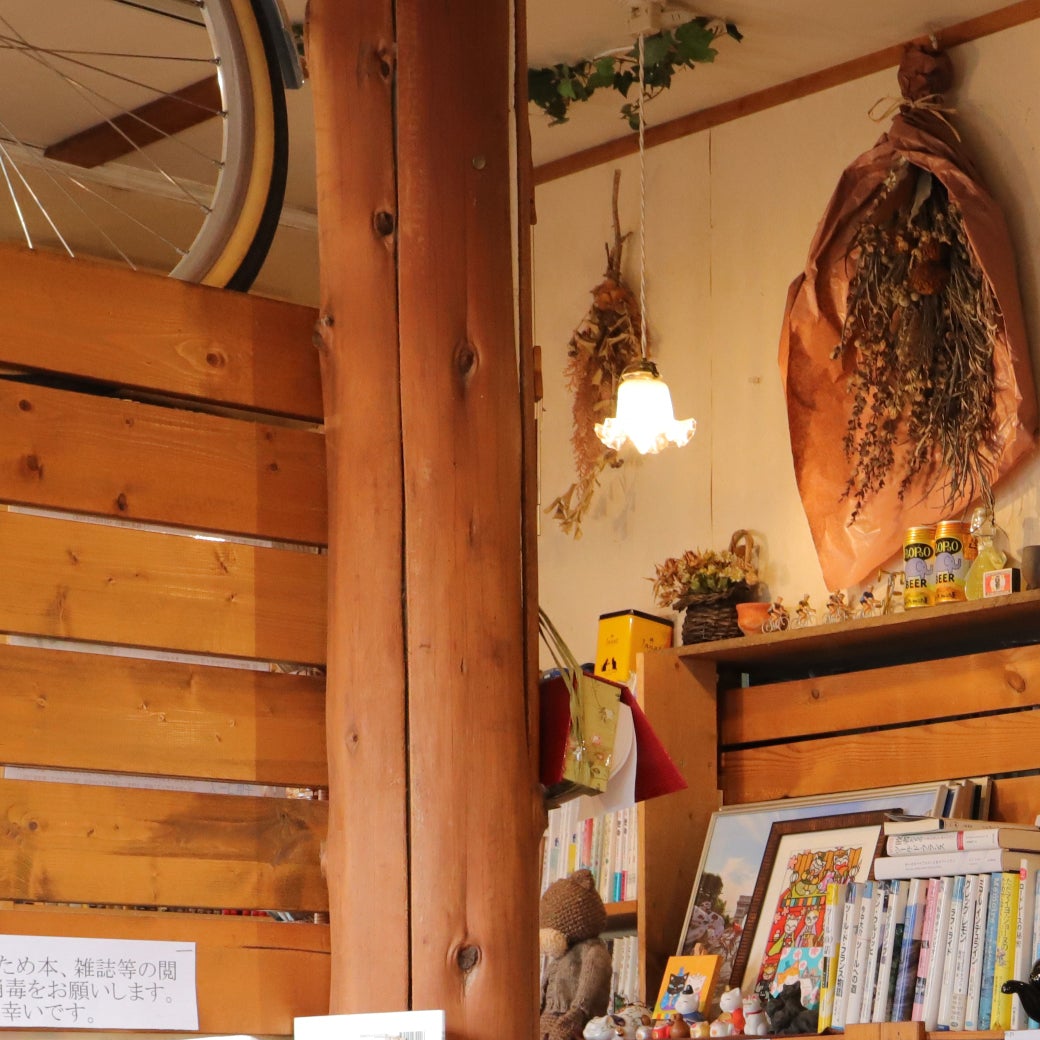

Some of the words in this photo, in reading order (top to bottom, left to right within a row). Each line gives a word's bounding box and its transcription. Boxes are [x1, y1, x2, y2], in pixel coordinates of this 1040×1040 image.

[0, 956, 177, 981] ため本、雑誌等の閲
[2, 1002, 94, 1024] 幸いです。
